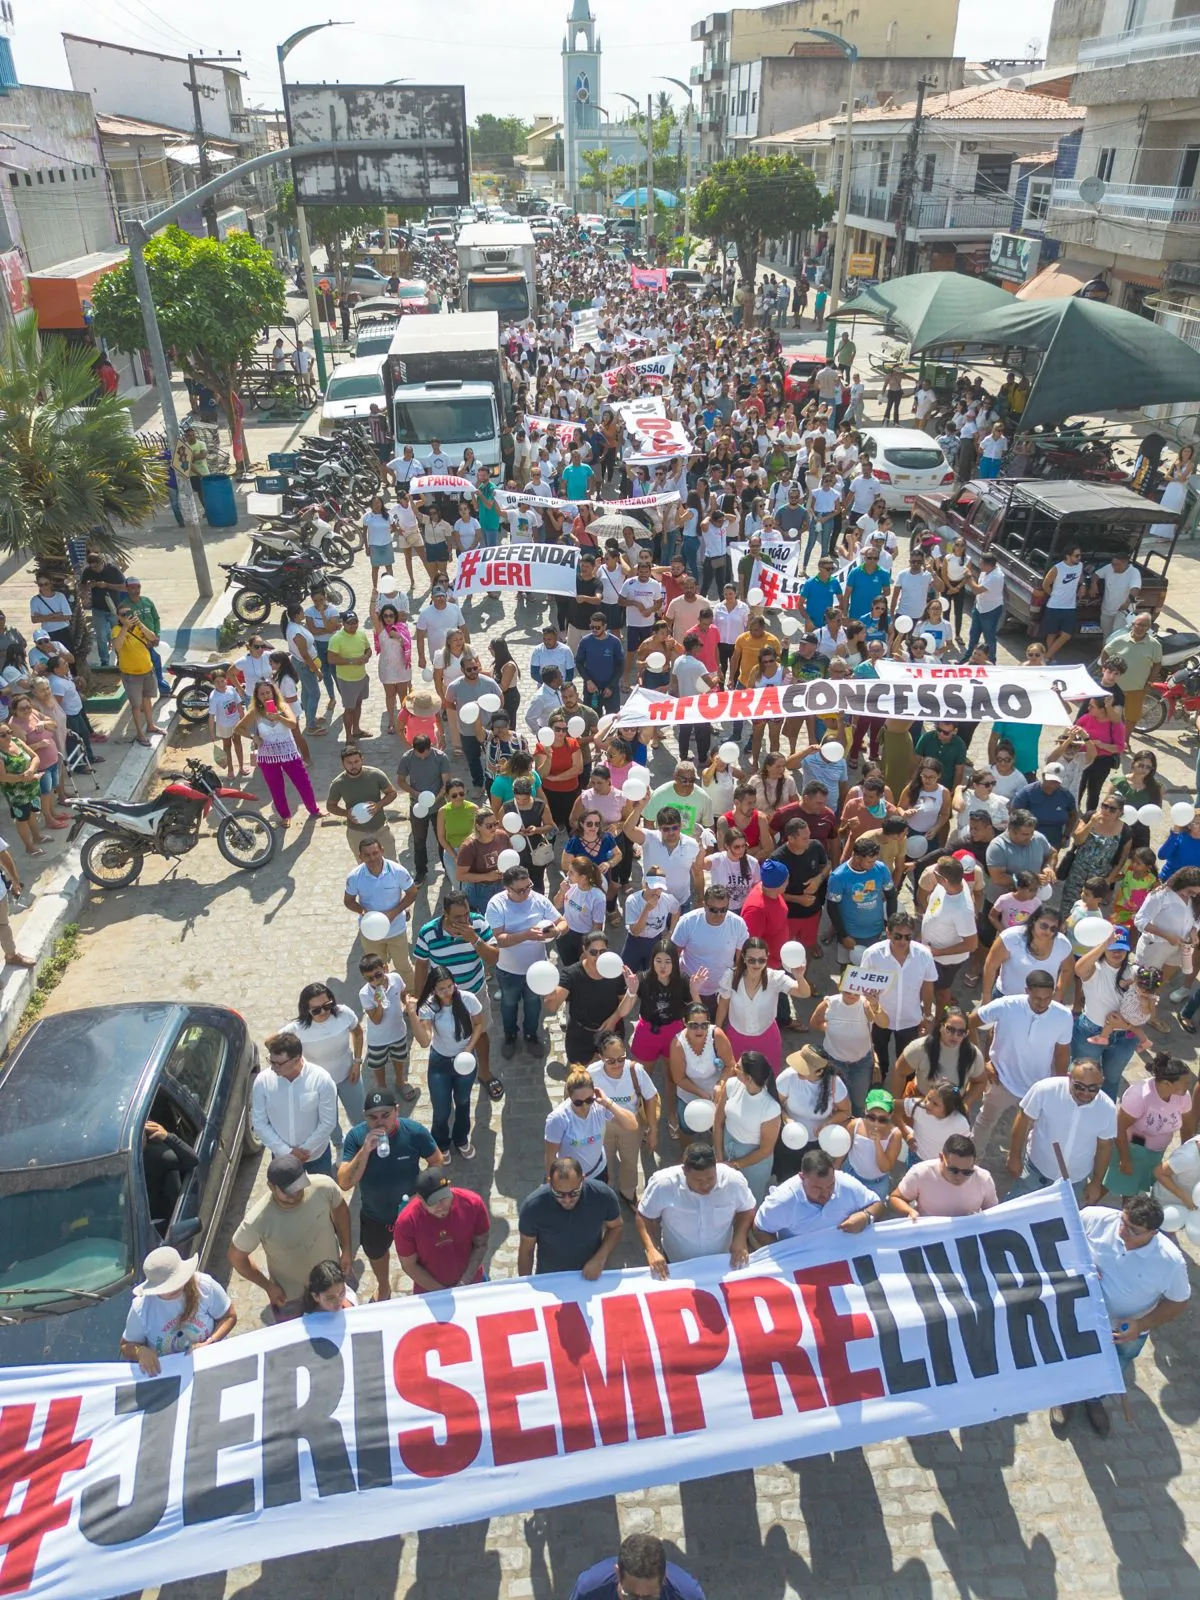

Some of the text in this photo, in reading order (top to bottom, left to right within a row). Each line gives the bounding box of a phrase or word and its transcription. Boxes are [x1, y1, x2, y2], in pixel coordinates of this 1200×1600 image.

[480, 562, 532, 587] JERI
[648, 679, 1033, 721] #FORACONCESSÃO
[861, 973, 889, 983] JERI
[0, 1217, 1102, 1596] #JERISEMPRELIVRE
